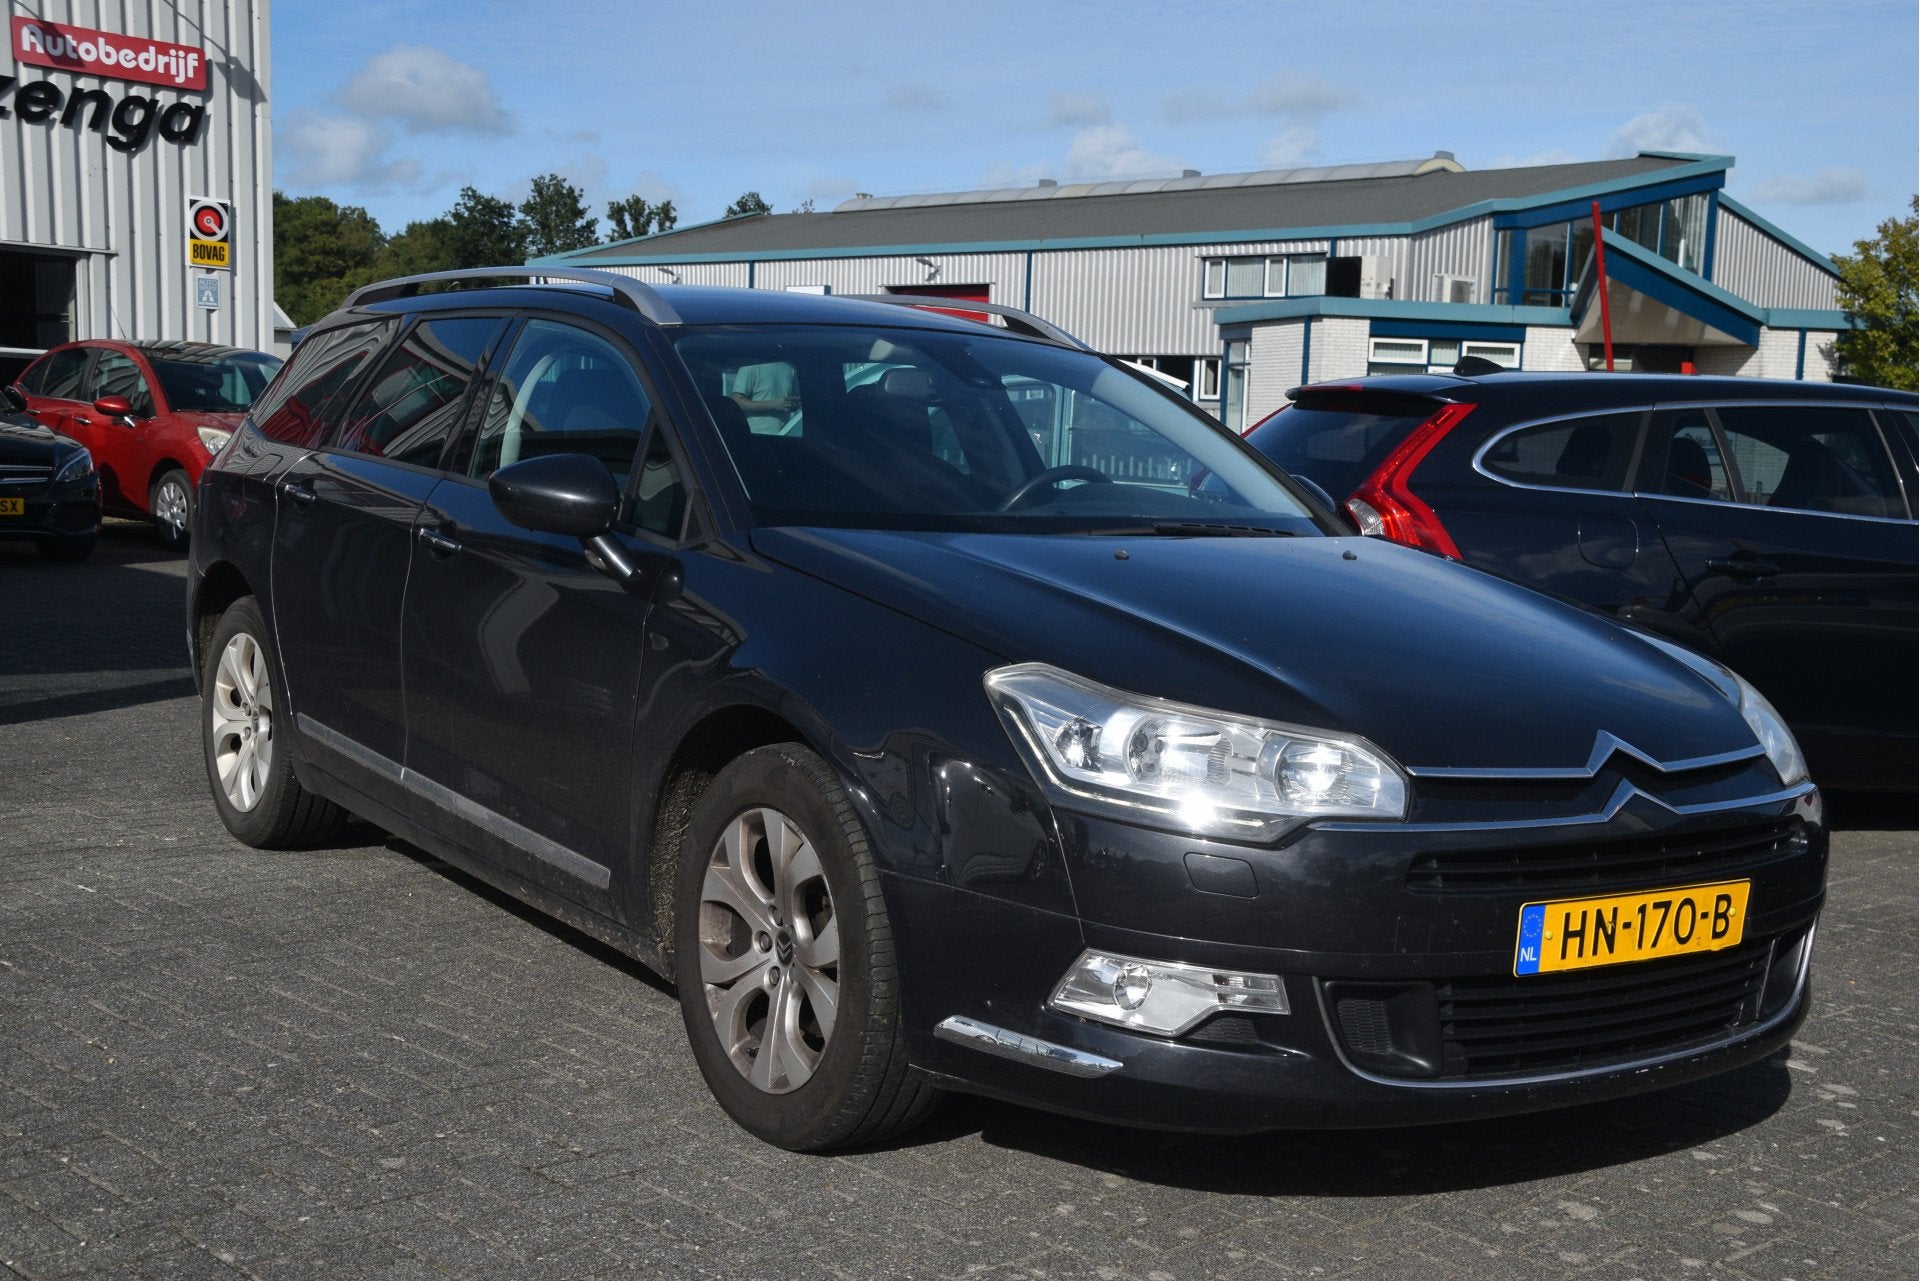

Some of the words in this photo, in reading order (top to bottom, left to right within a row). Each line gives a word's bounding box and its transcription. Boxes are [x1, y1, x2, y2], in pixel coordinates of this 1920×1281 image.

[20, 24, 199, 84] Autobedrijf
[192, 243, 225, 262] BOVAG
[1560, 893, 1733, 960] HN-170-B
[1520, 946, 1537, 963] NL
